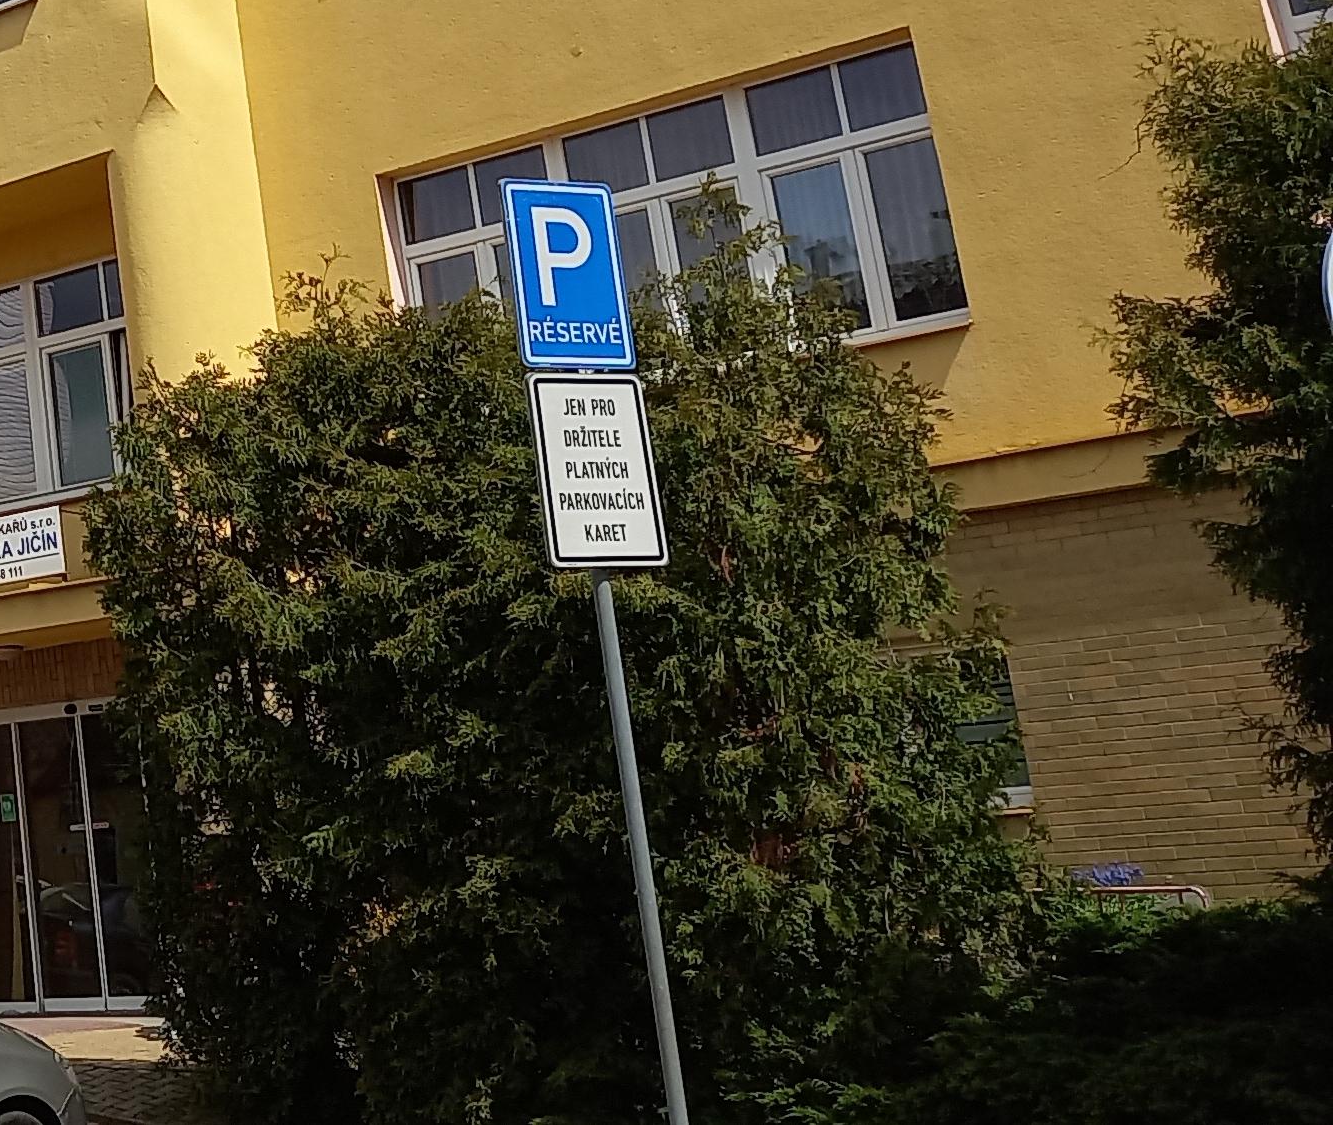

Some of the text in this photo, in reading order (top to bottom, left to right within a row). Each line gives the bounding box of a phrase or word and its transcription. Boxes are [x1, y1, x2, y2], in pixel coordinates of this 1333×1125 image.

[530, 206, 592, 307] P
[528, 315, 623, 345] RÉSERVÉ
[563, 398, 616, 417] JEN PRO
[563, 426, 622, 448] DRŽITELE
[565, 456, 630, 479] PLATNÝCH
[559, 488, 645, 511] PARKOVACÍCH
[17, 530, 59, 557] JIČÍN
[584, 523, 627, 543] KARET
[8, 566, 24, 579] 111
